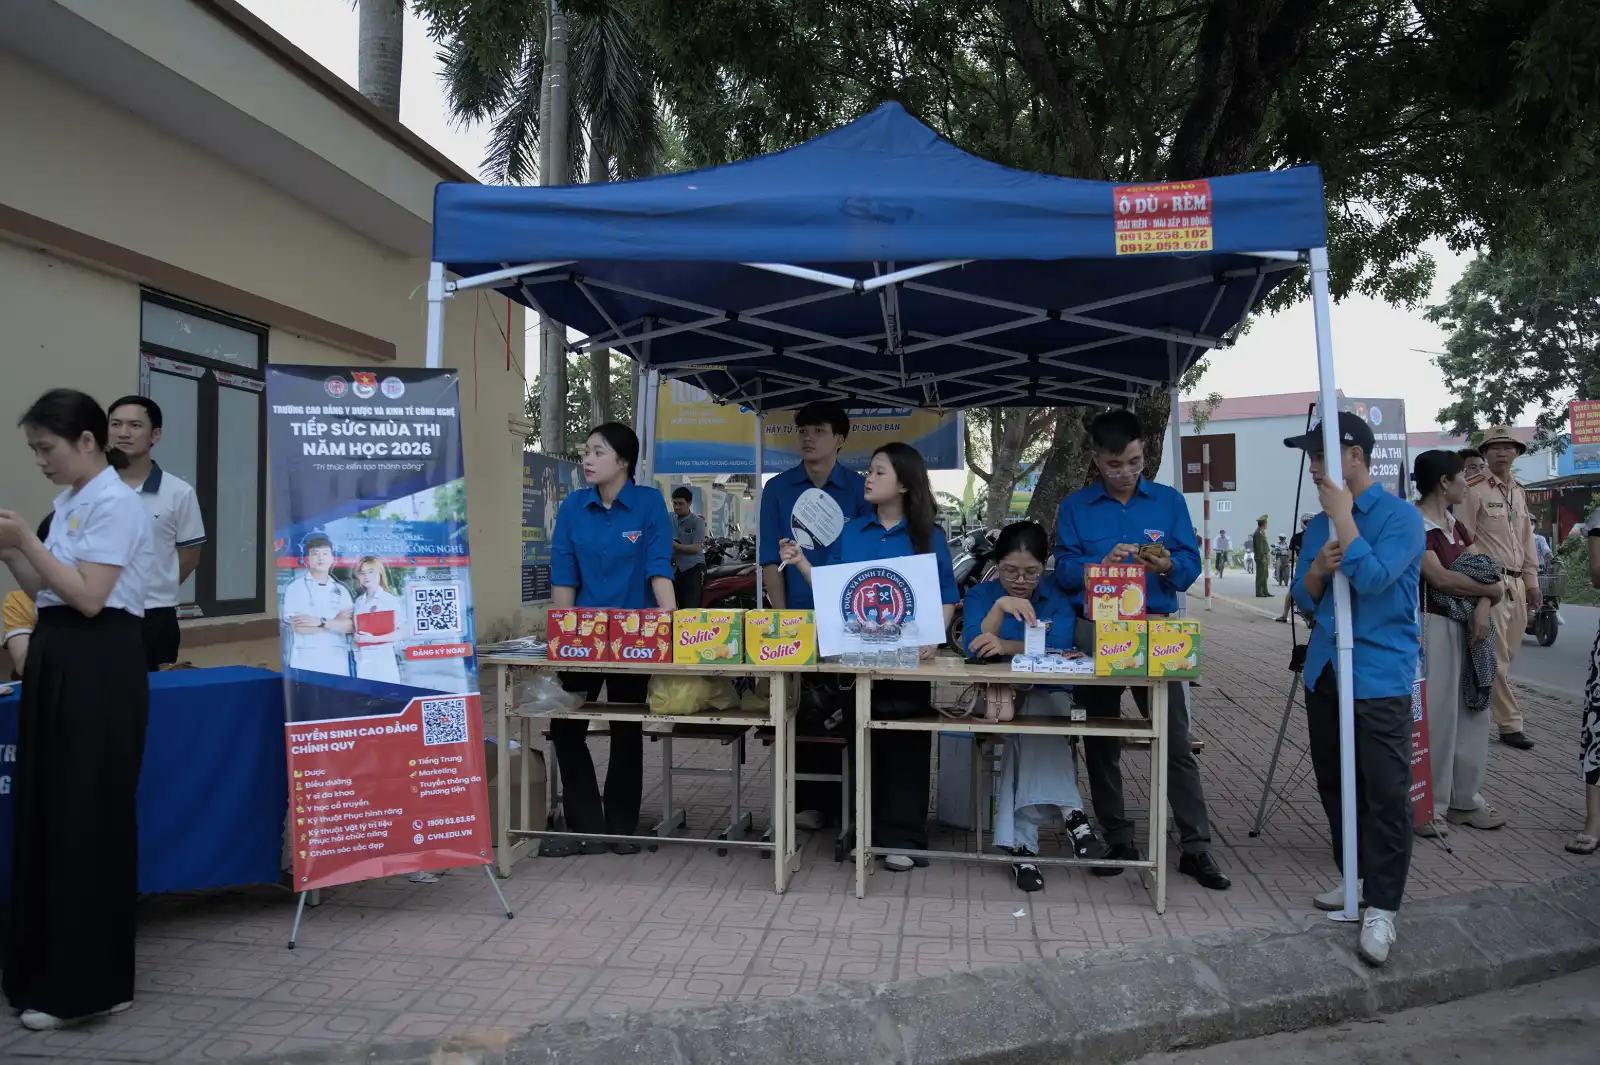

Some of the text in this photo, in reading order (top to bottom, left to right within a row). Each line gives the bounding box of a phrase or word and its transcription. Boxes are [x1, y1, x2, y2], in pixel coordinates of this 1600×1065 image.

[1119, 196, 1130, 214] Ô
[1135, 194, 1158, 214] DÙ
[1120, 230, 1208, 242] 0913.258.102
[1120, 240, 1208, 253] 0912.053.678
[306, 406, 321, 415] CAO
[345, 406, 351, 415] Y
[386, 407, 404, 415] KINH
[436, 407, 455, 417] NGHỆ
[290, 416, 440, 436] TIẾP SỨC MÙA THI
[766, 424, 781, 434] HÃY
[783, 424, 793, 435] TỰ
[852, 424, 862, 432] ĐI
[863, 422, 883, 432] CÙNG
[303, 439, 432, 459] NĂM HỌC 2026
[1371, 444, 1401, 459] MÙA THI
[1380, 464, 1399, 476] 2026
[850, 578, 859, 589] VÀ
[858, 571, 876, 581] KINH
[886, 572, 904, 588] CÔNG
[1093, 584, 1117, 594] COSY
[782, 618, 800, 627] Solite
[679, 630, 714, 646] Solite
[412, 648, 434, 656] ĐĂNG
[560, 645, 592, 658] COSY
[622, 646, 656, 659] COSY
[760, 644, 795, 661] Solite
[1100, 643, 1128, 656] Solite
[1152, 643, 1180, 657] Solite
[330, 729, 357, 739] SINH
[359, 726, 384, 736] CAO
[386, 721, 418, 734] ĐẲNG
[291, 741, 355, 754] CHÍNH QUY
[418, 757, 439, 765] Tiếng
[419, 767, 457, 776] Marketing
[314, 804, 329, 812] học
[344, 812, 363, 820] Phục
[427, 815, 475, 827] 1900 63.63.65
[428, 829, 472, 840] CVN.EDU.VN
[309, 838, 330, 846] Phục
